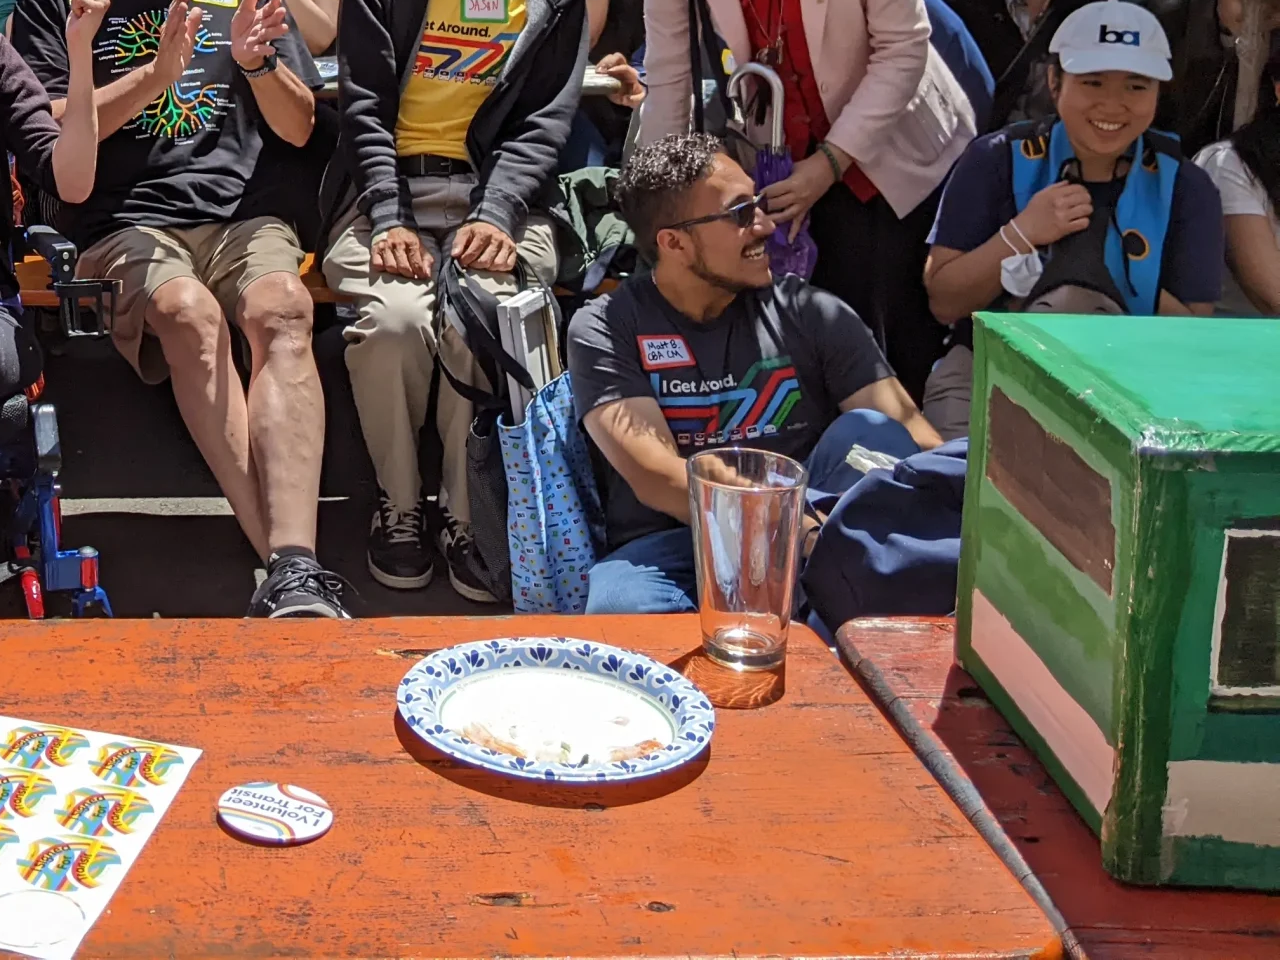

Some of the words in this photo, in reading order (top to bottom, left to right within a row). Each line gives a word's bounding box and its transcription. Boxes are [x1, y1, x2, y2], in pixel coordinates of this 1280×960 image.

[438, 20, 491, 38] Around.
[647, 340, 669, 350] Matt
[670, 339, 681, 350] B.
[662, 380, 668, 393] I
[670, 380, 696, 393] Get
[14, 732, 45, 750] Signed
[32, 741, 46, 752] For
[48, 739, 63, 760] Transit
[106, 748, 137, 768] Signed
[125, 757, 138, 770] For
[144, 756, 158, 780] Transit
[14, 785, 30, 810] Transit
[224, 796, 308, 824] Volunteer
[230, 788, 289, 808] Transit
[74, 795, 106, 819] Signed
[92, 806, 106, 818] For
[112, 804, 126, 826] Transit
[296, 804, 326, 818] For
[38, 844, 72, 871] Signed
[56, 856, 72, 870] For
[76, 853, 92, 881] Transit
